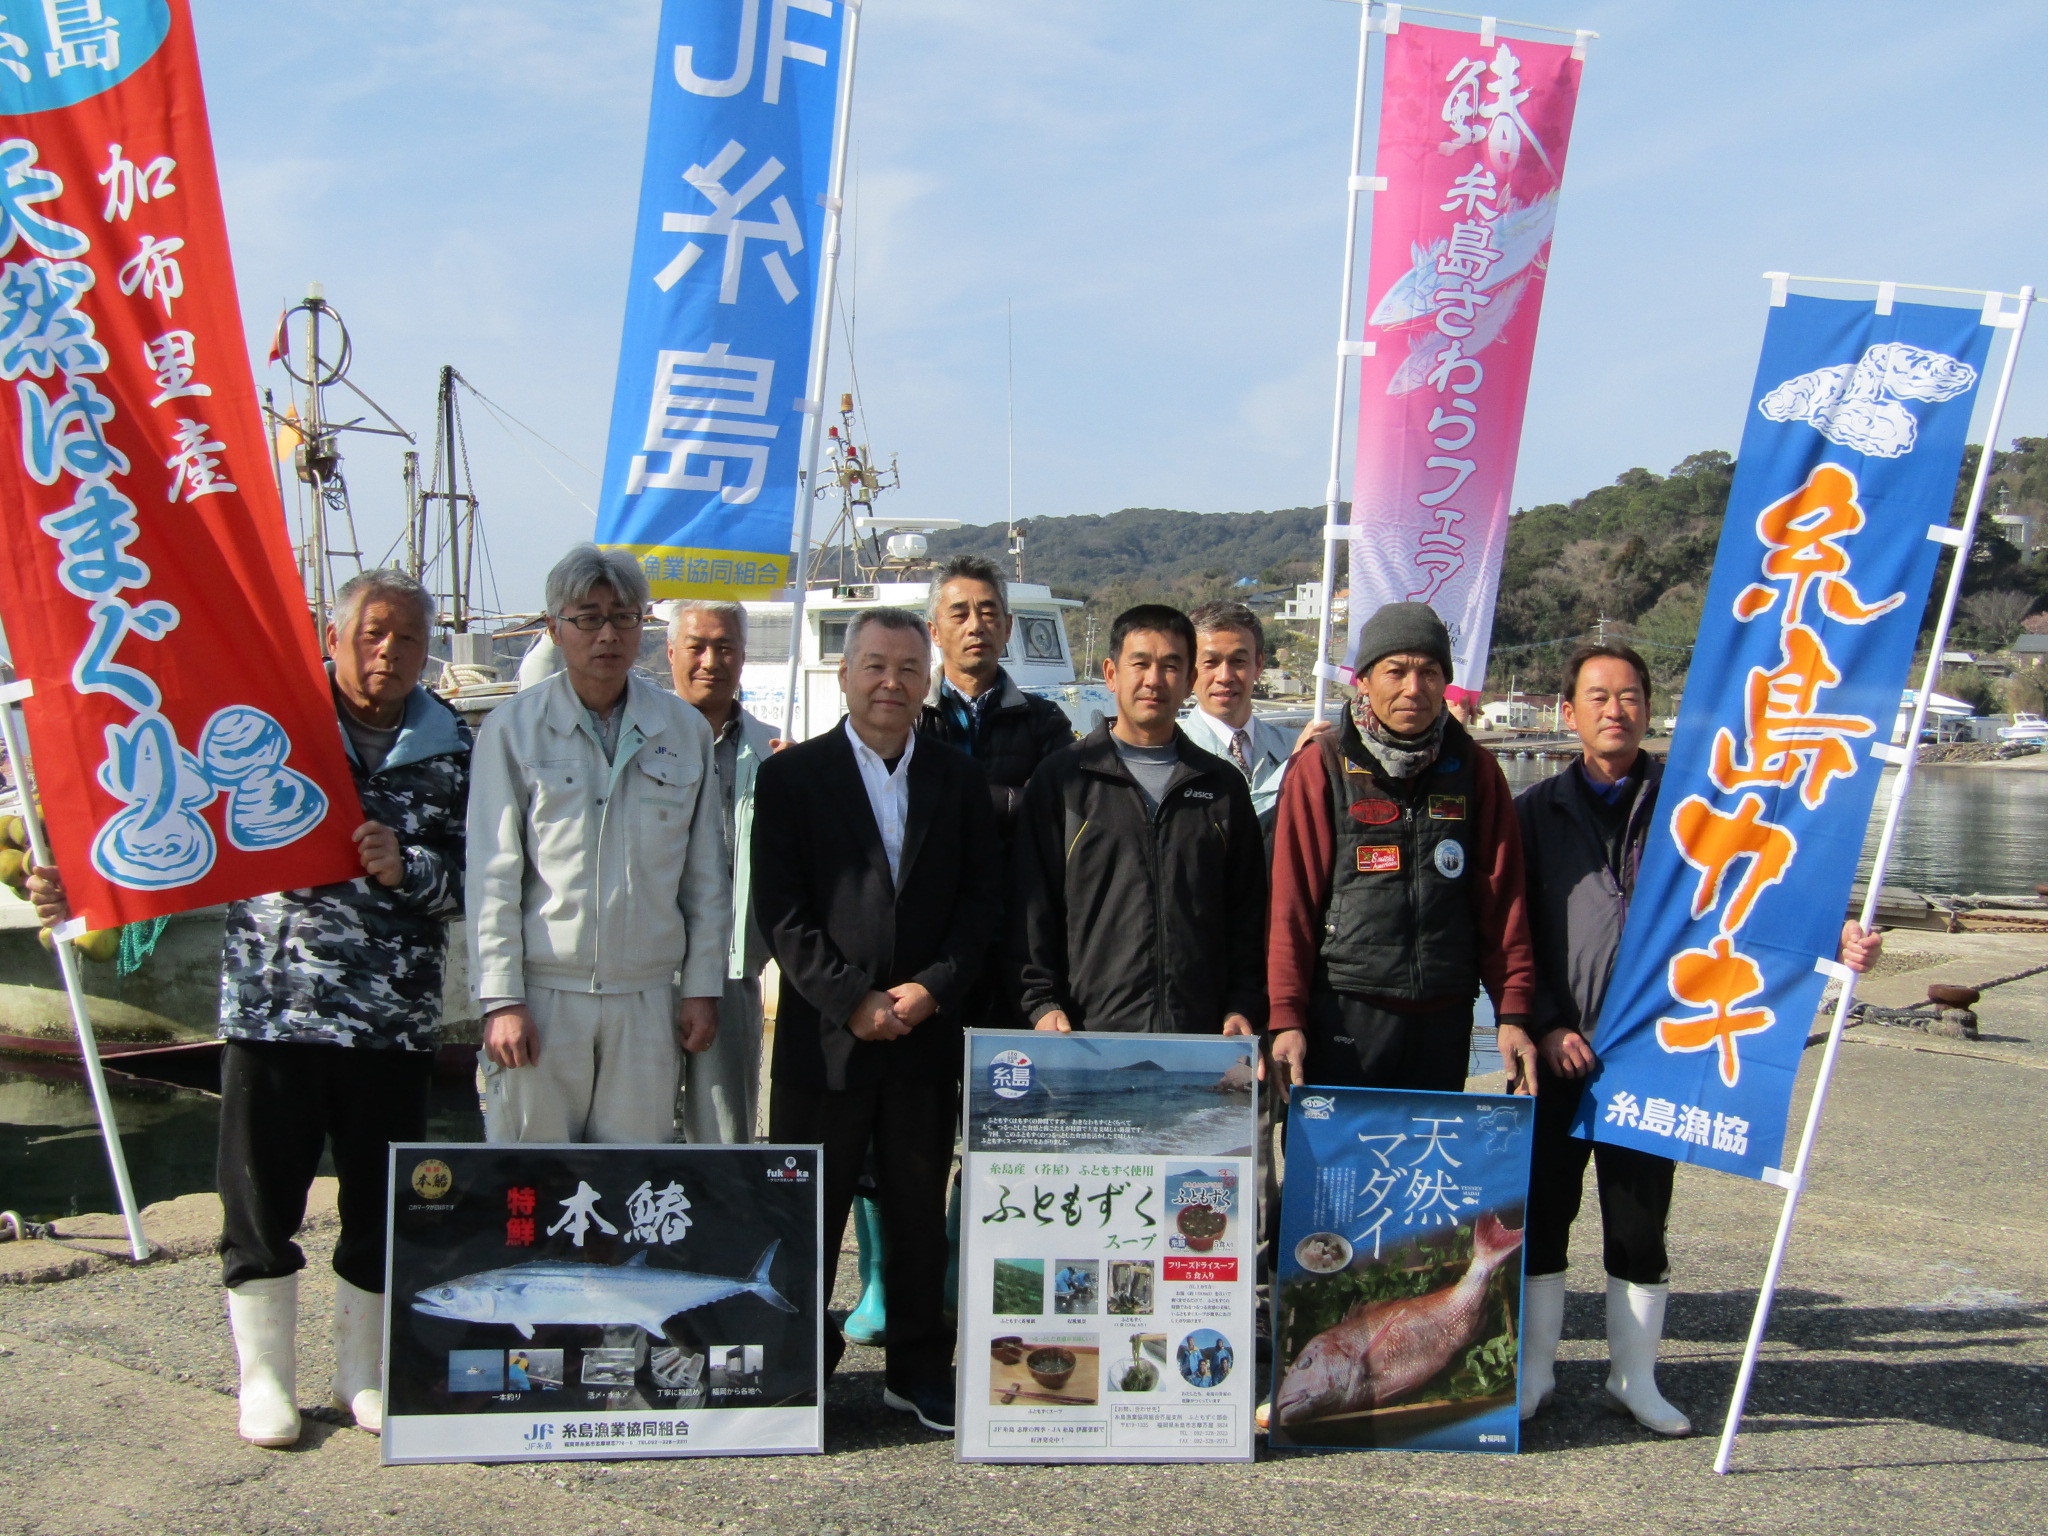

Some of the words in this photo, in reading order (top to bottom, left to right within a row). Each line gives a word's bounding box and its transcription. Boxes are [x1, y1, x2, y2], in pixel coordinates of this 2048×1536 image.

[0, 0, 120, 83] 島
[98, 143, 237, 504] 加布里産
[1406, 162, 1503, 604] 糸島さわらフェア
[1192, 791, 1213, 799] asics
[1655, 462, 1906, 1089] 糸島カキ
[992, 1067, 1030, 1087] 糸島
[1605, 1090, 1750, 1156] 糸島漁協
[1353, 1132, 1409, 1260] マダイ
[1404, 1115, 1464, 1227] 天然
[506, 1186, 536, 1246] 特鮮
[546, 1180, 694, 1247] 本鰆
[982, 1181, 1157, 1229] ふともずく
[1104, 1232, 1157, 1251] スープ
[1168, 1261, 1236, 1269] フリーズドライスープ
[491, 1393, 522, 1402] 一本釣り
[711, 1387, 763, 1396] 福岡から各地へ
[561, 1420, 690, 1439] 糸島漁業協同組合
